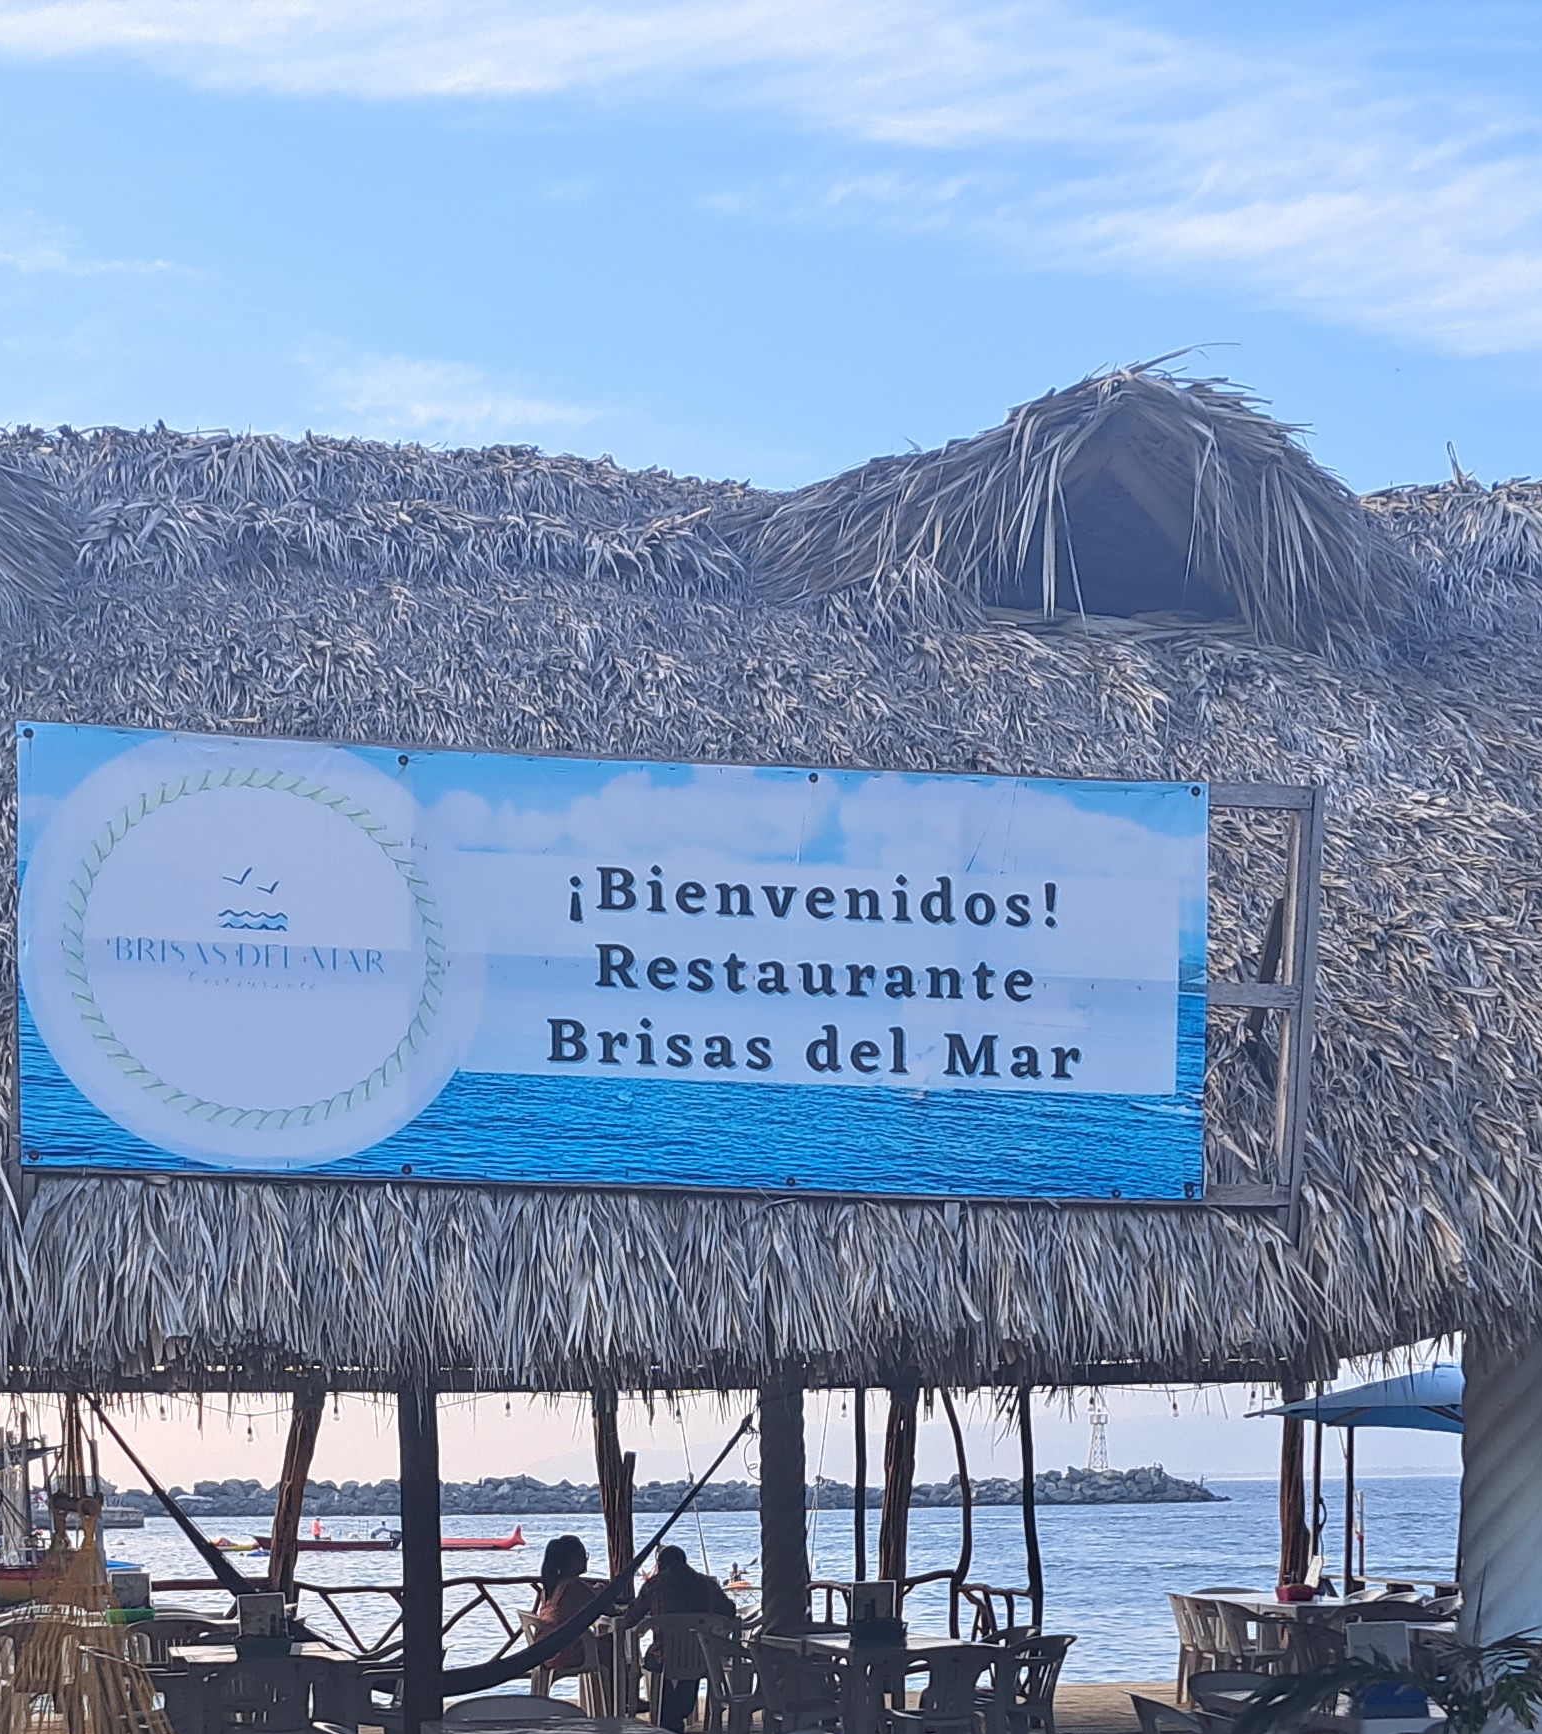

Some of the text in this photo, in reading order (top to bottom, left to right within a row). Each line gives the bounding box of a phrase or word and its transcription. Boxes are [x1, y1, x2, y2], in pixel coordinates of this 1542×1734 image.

[568, 865, 1058, 929] ¡Bienvenidos!
[115, 936, 385, 974] BRISAS DEL MAR
[595, 943, 1035, 1002] Restaurante
[546, 1017, 1082, 1080] Brisas del Mar
